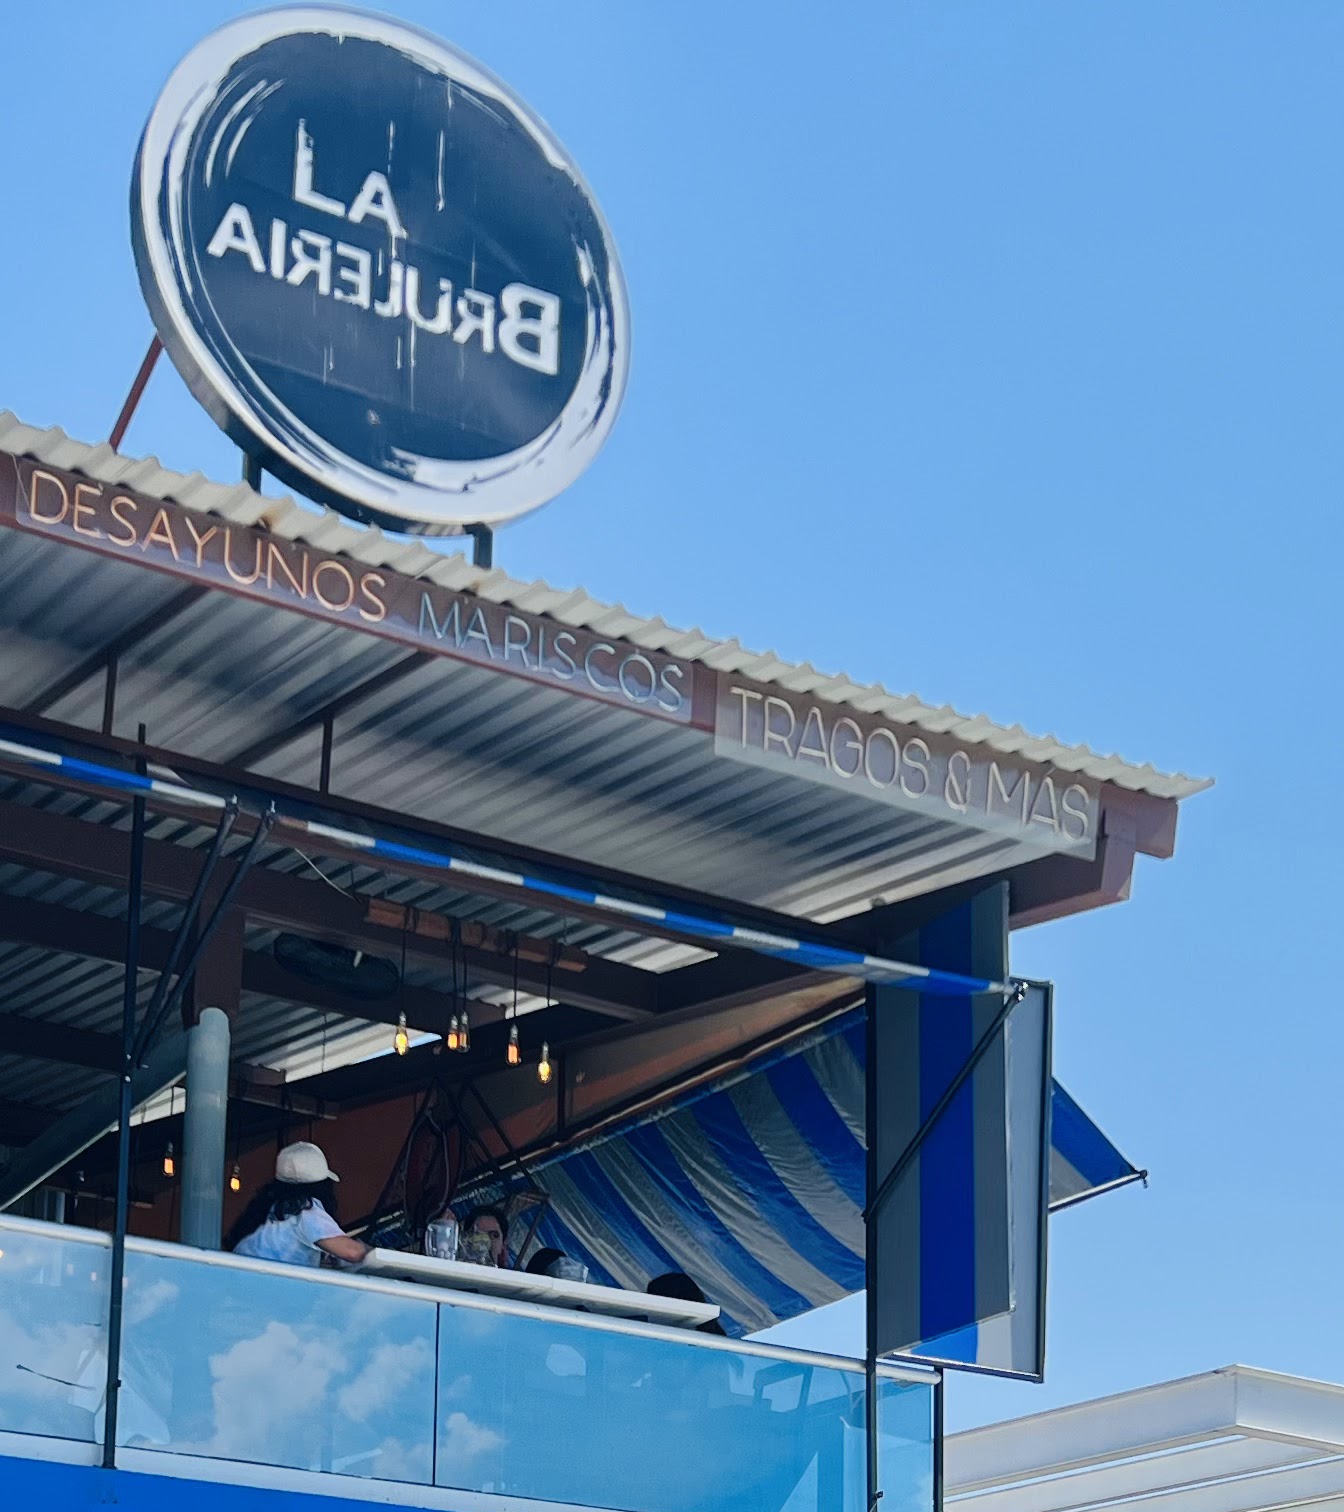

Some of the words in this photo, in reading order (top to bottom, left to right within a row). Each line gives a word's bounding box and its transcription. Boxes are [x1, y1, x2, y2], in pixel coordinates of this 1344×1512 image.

[293, 118, 408, 239] LA
[29, 470, 386, 622] DESAYUNOS
[418, 592, 683, 712] MARISCOS
[730, 687, 930, 798] TRAGOS
[944, 750, 970, 814] &
